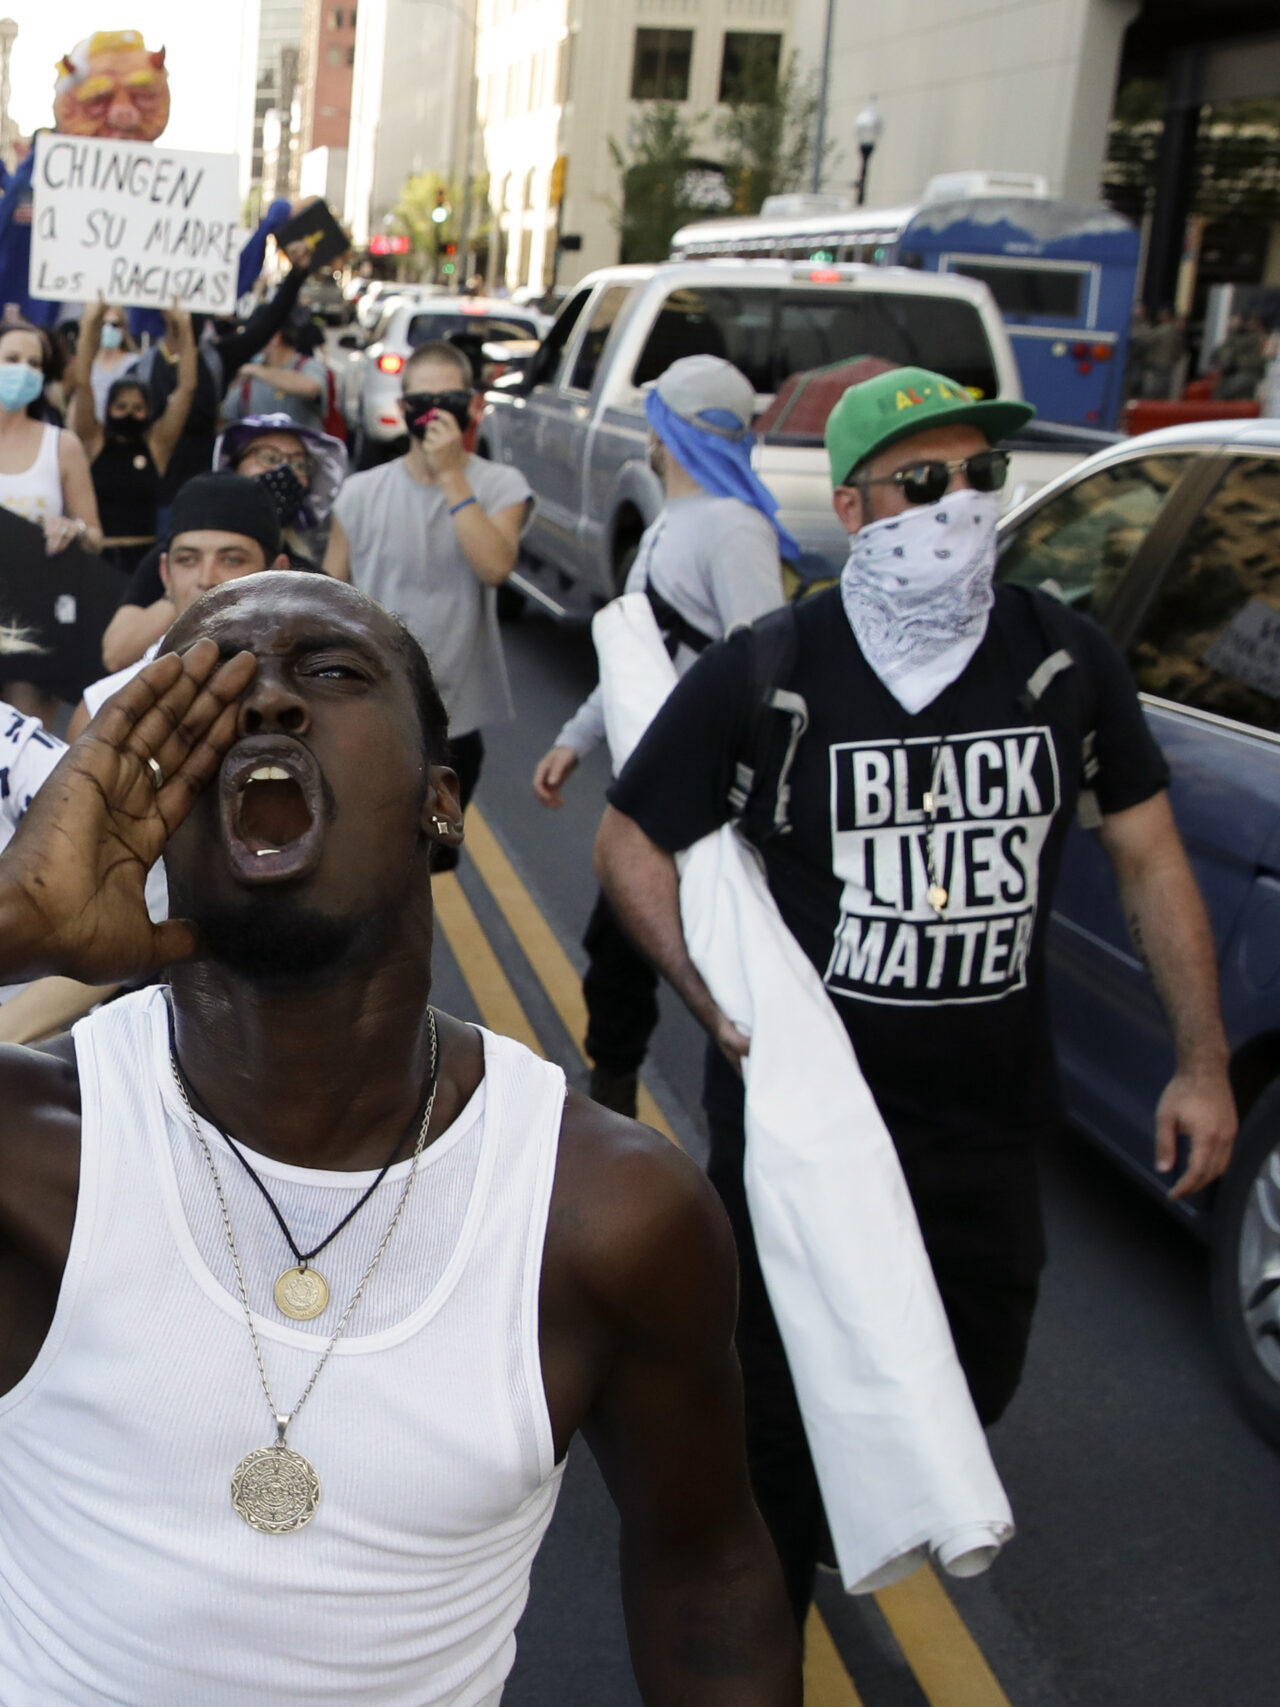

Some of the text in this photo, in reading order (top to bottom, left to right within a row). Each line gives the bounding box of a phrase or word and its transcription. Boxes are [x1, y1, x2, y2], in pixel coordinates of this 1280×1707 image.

[43, 142, 205, 209] CHINGEN
[80, 207, 127, 249] SU
[143, 216, 237, 263] MADRE
[107, 256, 229, 307] RACISTAS
[852, 735, 1043, 828] BLACK
[863, 825, 1028, 912] LIVES
